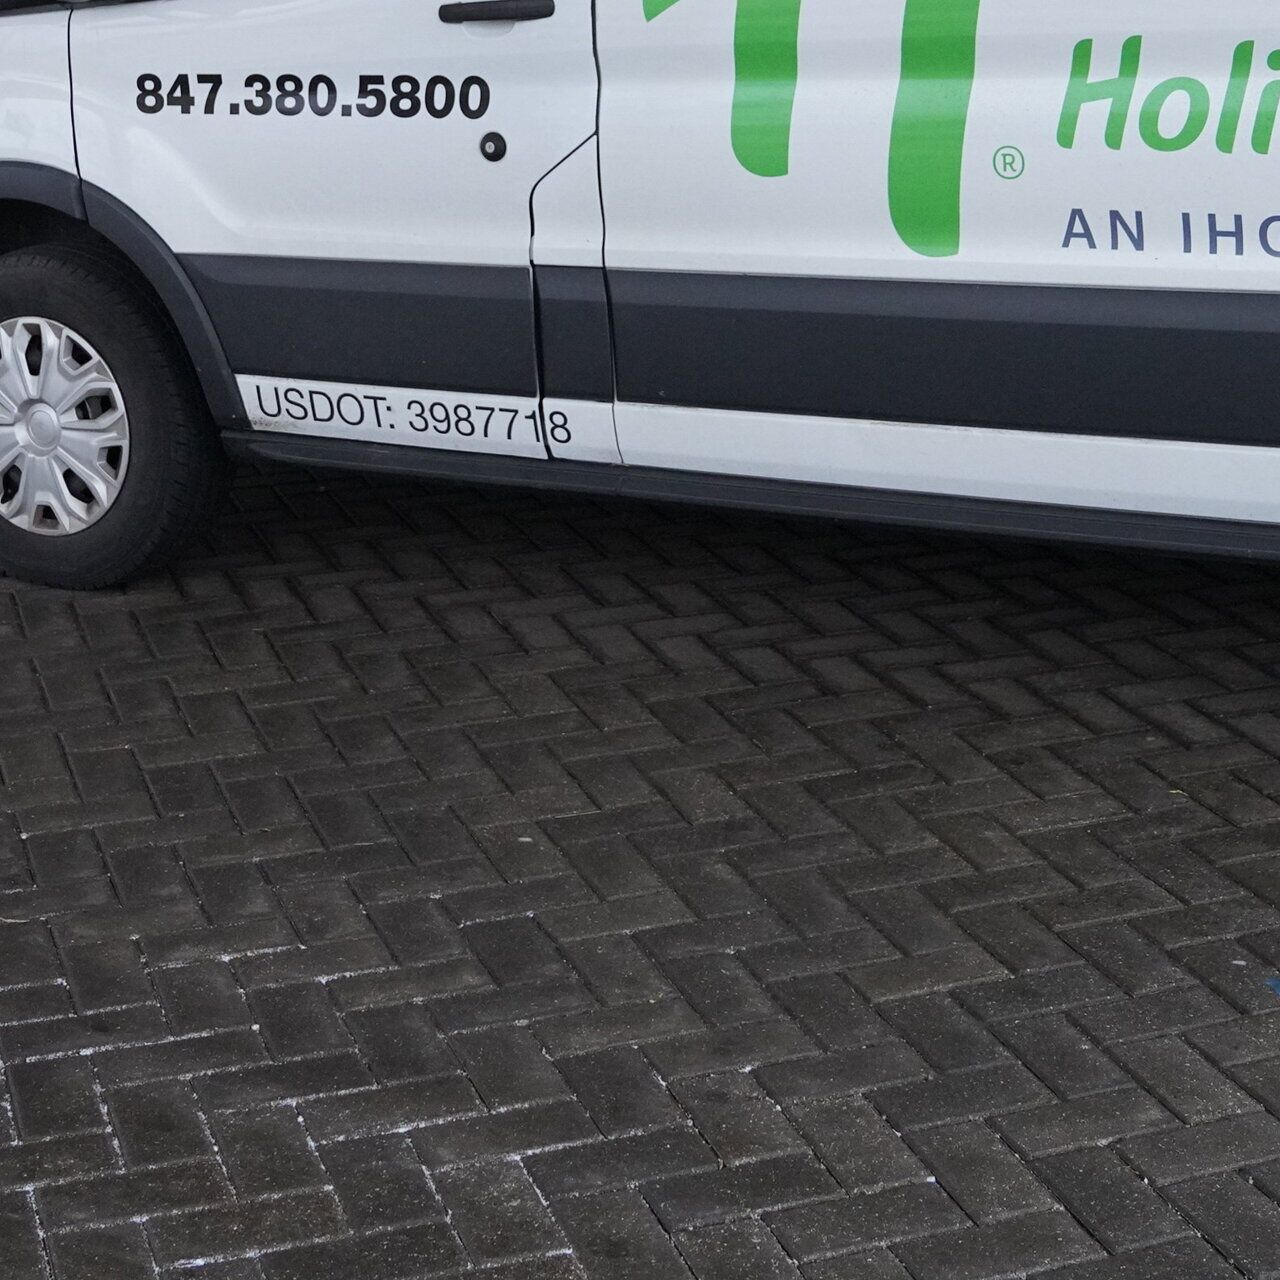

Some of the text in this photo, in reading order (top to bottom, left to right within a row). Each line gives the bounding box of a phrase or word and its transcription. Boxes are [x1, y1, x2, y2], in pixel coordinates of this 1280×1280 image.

[136, 73, 491, 120] 847.380.5800
[1061, 208, 1145, 252] AN
[255, 384, 572, 444] USDOT: 3987718
